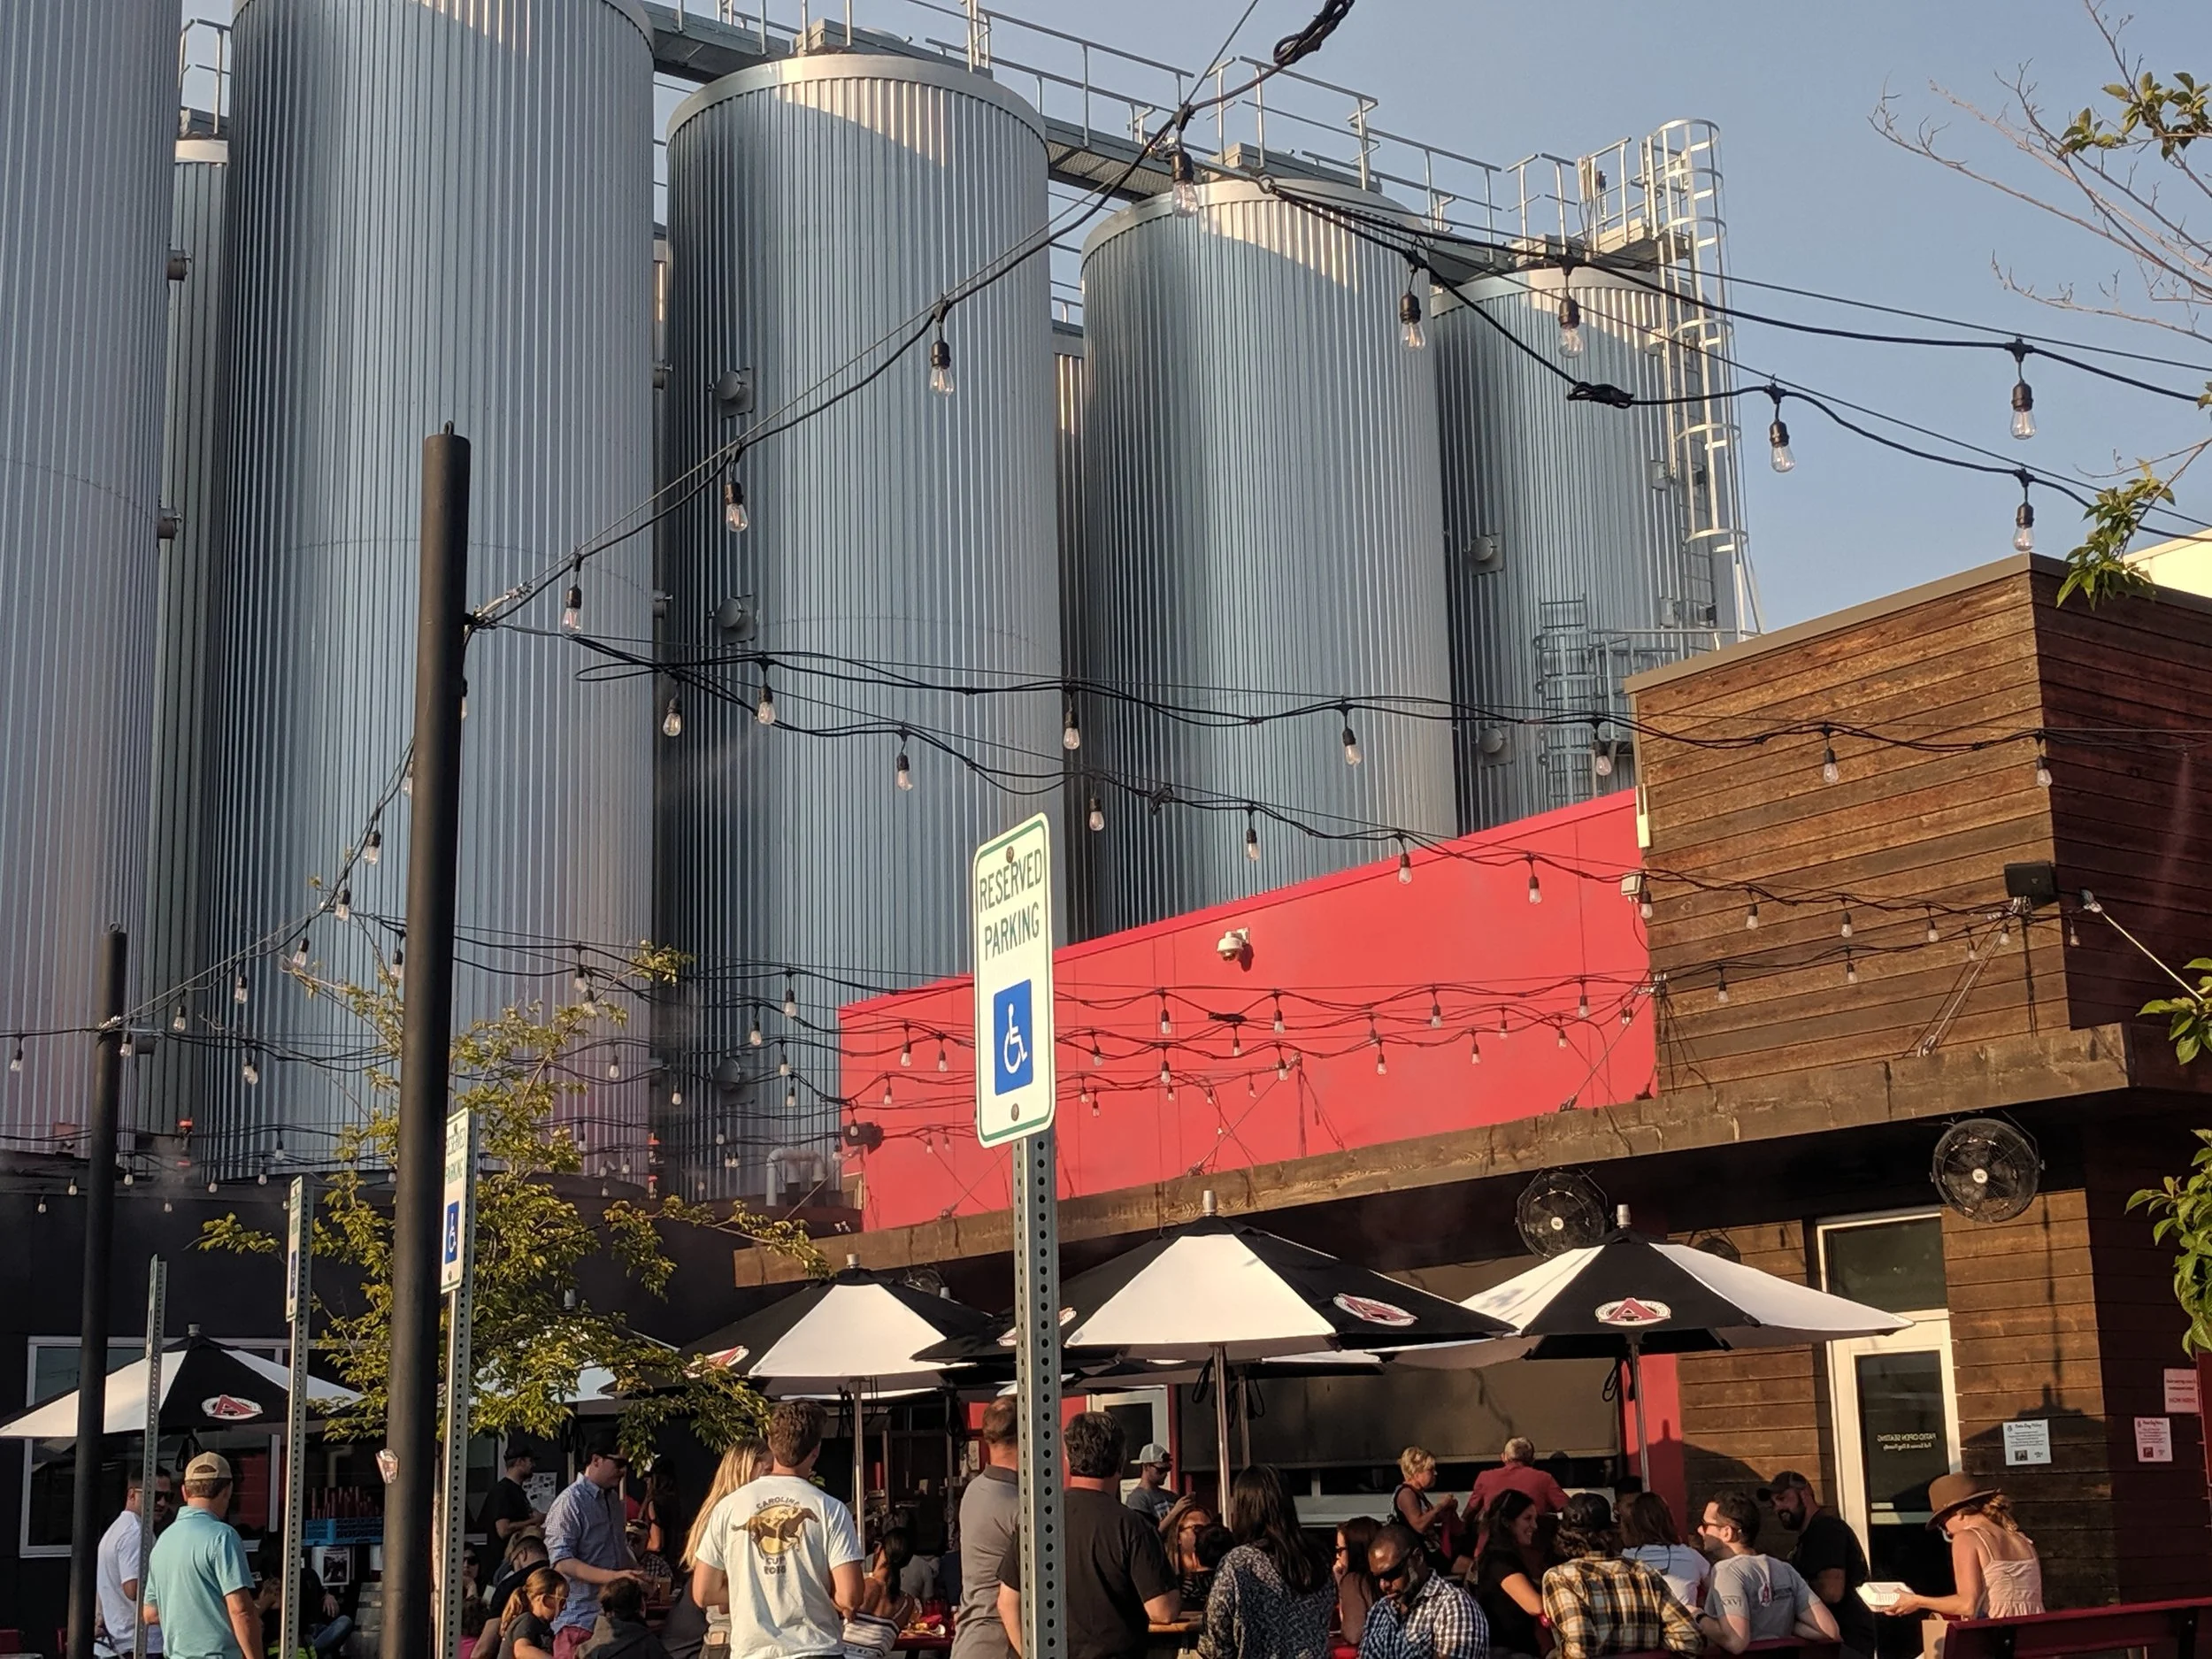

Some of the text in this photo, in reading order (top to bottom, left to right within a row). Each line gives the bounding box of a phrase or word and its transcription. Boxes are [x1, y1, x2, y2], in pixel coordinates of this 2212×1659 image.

[979, 848, 1042, 913] RESERVED
[985, 902, 1040, 961] PARKING
[765, 1555, 786, 1565] CUP
